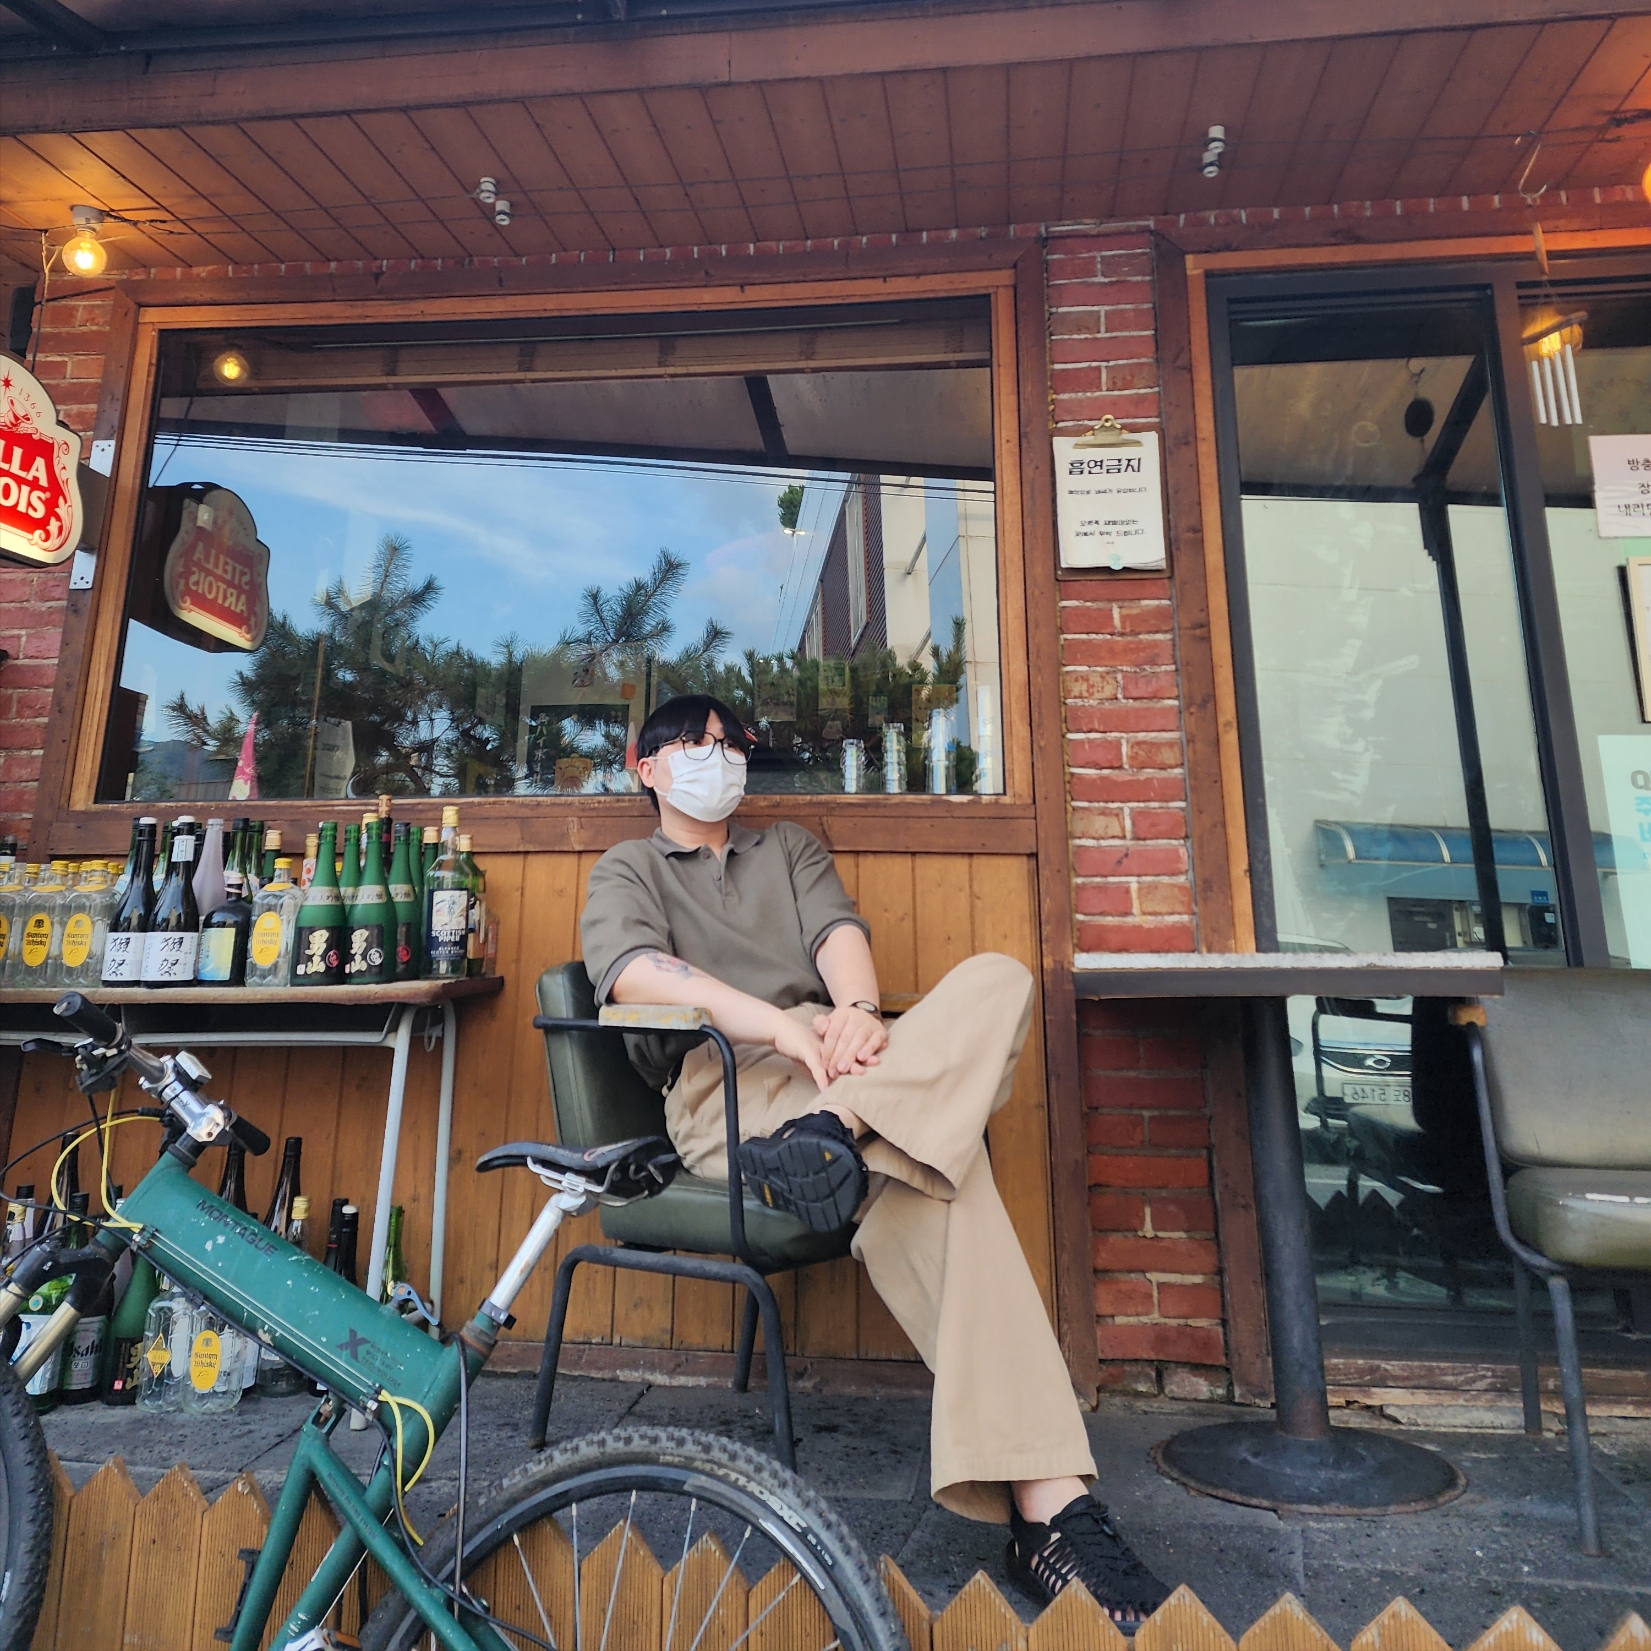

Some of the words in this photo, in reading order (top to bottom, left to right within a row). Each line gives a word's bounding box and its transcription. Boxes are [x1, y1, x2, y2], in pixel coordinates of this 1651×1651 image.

[1068, 457, 1142, 475] 흡연금지
[26, 932, 49, 940] Suntory
[66, 932, 89, 940] Suntory
[196, 1199, 279, 1257] MONTAGUE
[194, 1352, 218, 1360] Suntory
